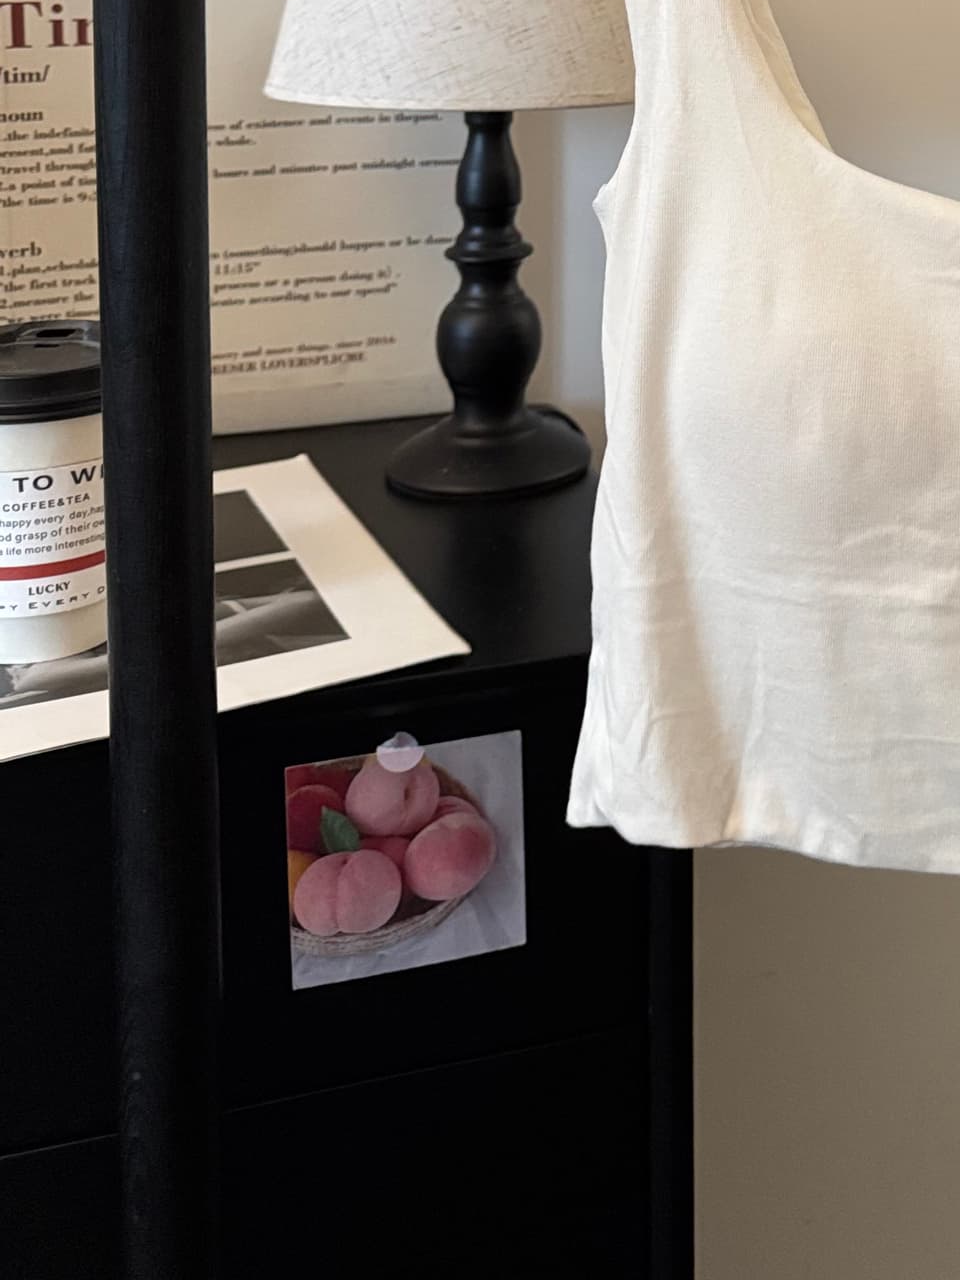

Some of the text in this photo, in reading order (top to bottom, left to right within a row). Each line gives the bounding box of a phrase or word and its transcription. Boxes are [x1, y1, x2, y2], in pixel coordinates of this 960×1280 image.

[252, 164, 276, 176] and
[21, 179, 56, 193] point
[60, 175, 76, 187] of
[28, 195, 60, 207] time
[30, 279, 58, 291] first
[73, 291, 94, 302] the
[12, 475, 54, 493] TO
[2, 493, 91, 513] COFFEE&TEA
[34, 514, 65, 527] every
[15, 531, 48, 544] grasp
[50, 527, 63, 538] of
[65, 522, 91, 535] their
[6, 546, 22, 556] life
[24, 544, 53, 555] more
[28, 581, 71, 596] LUCKY
[28, 592, 90, 610] EVERY
